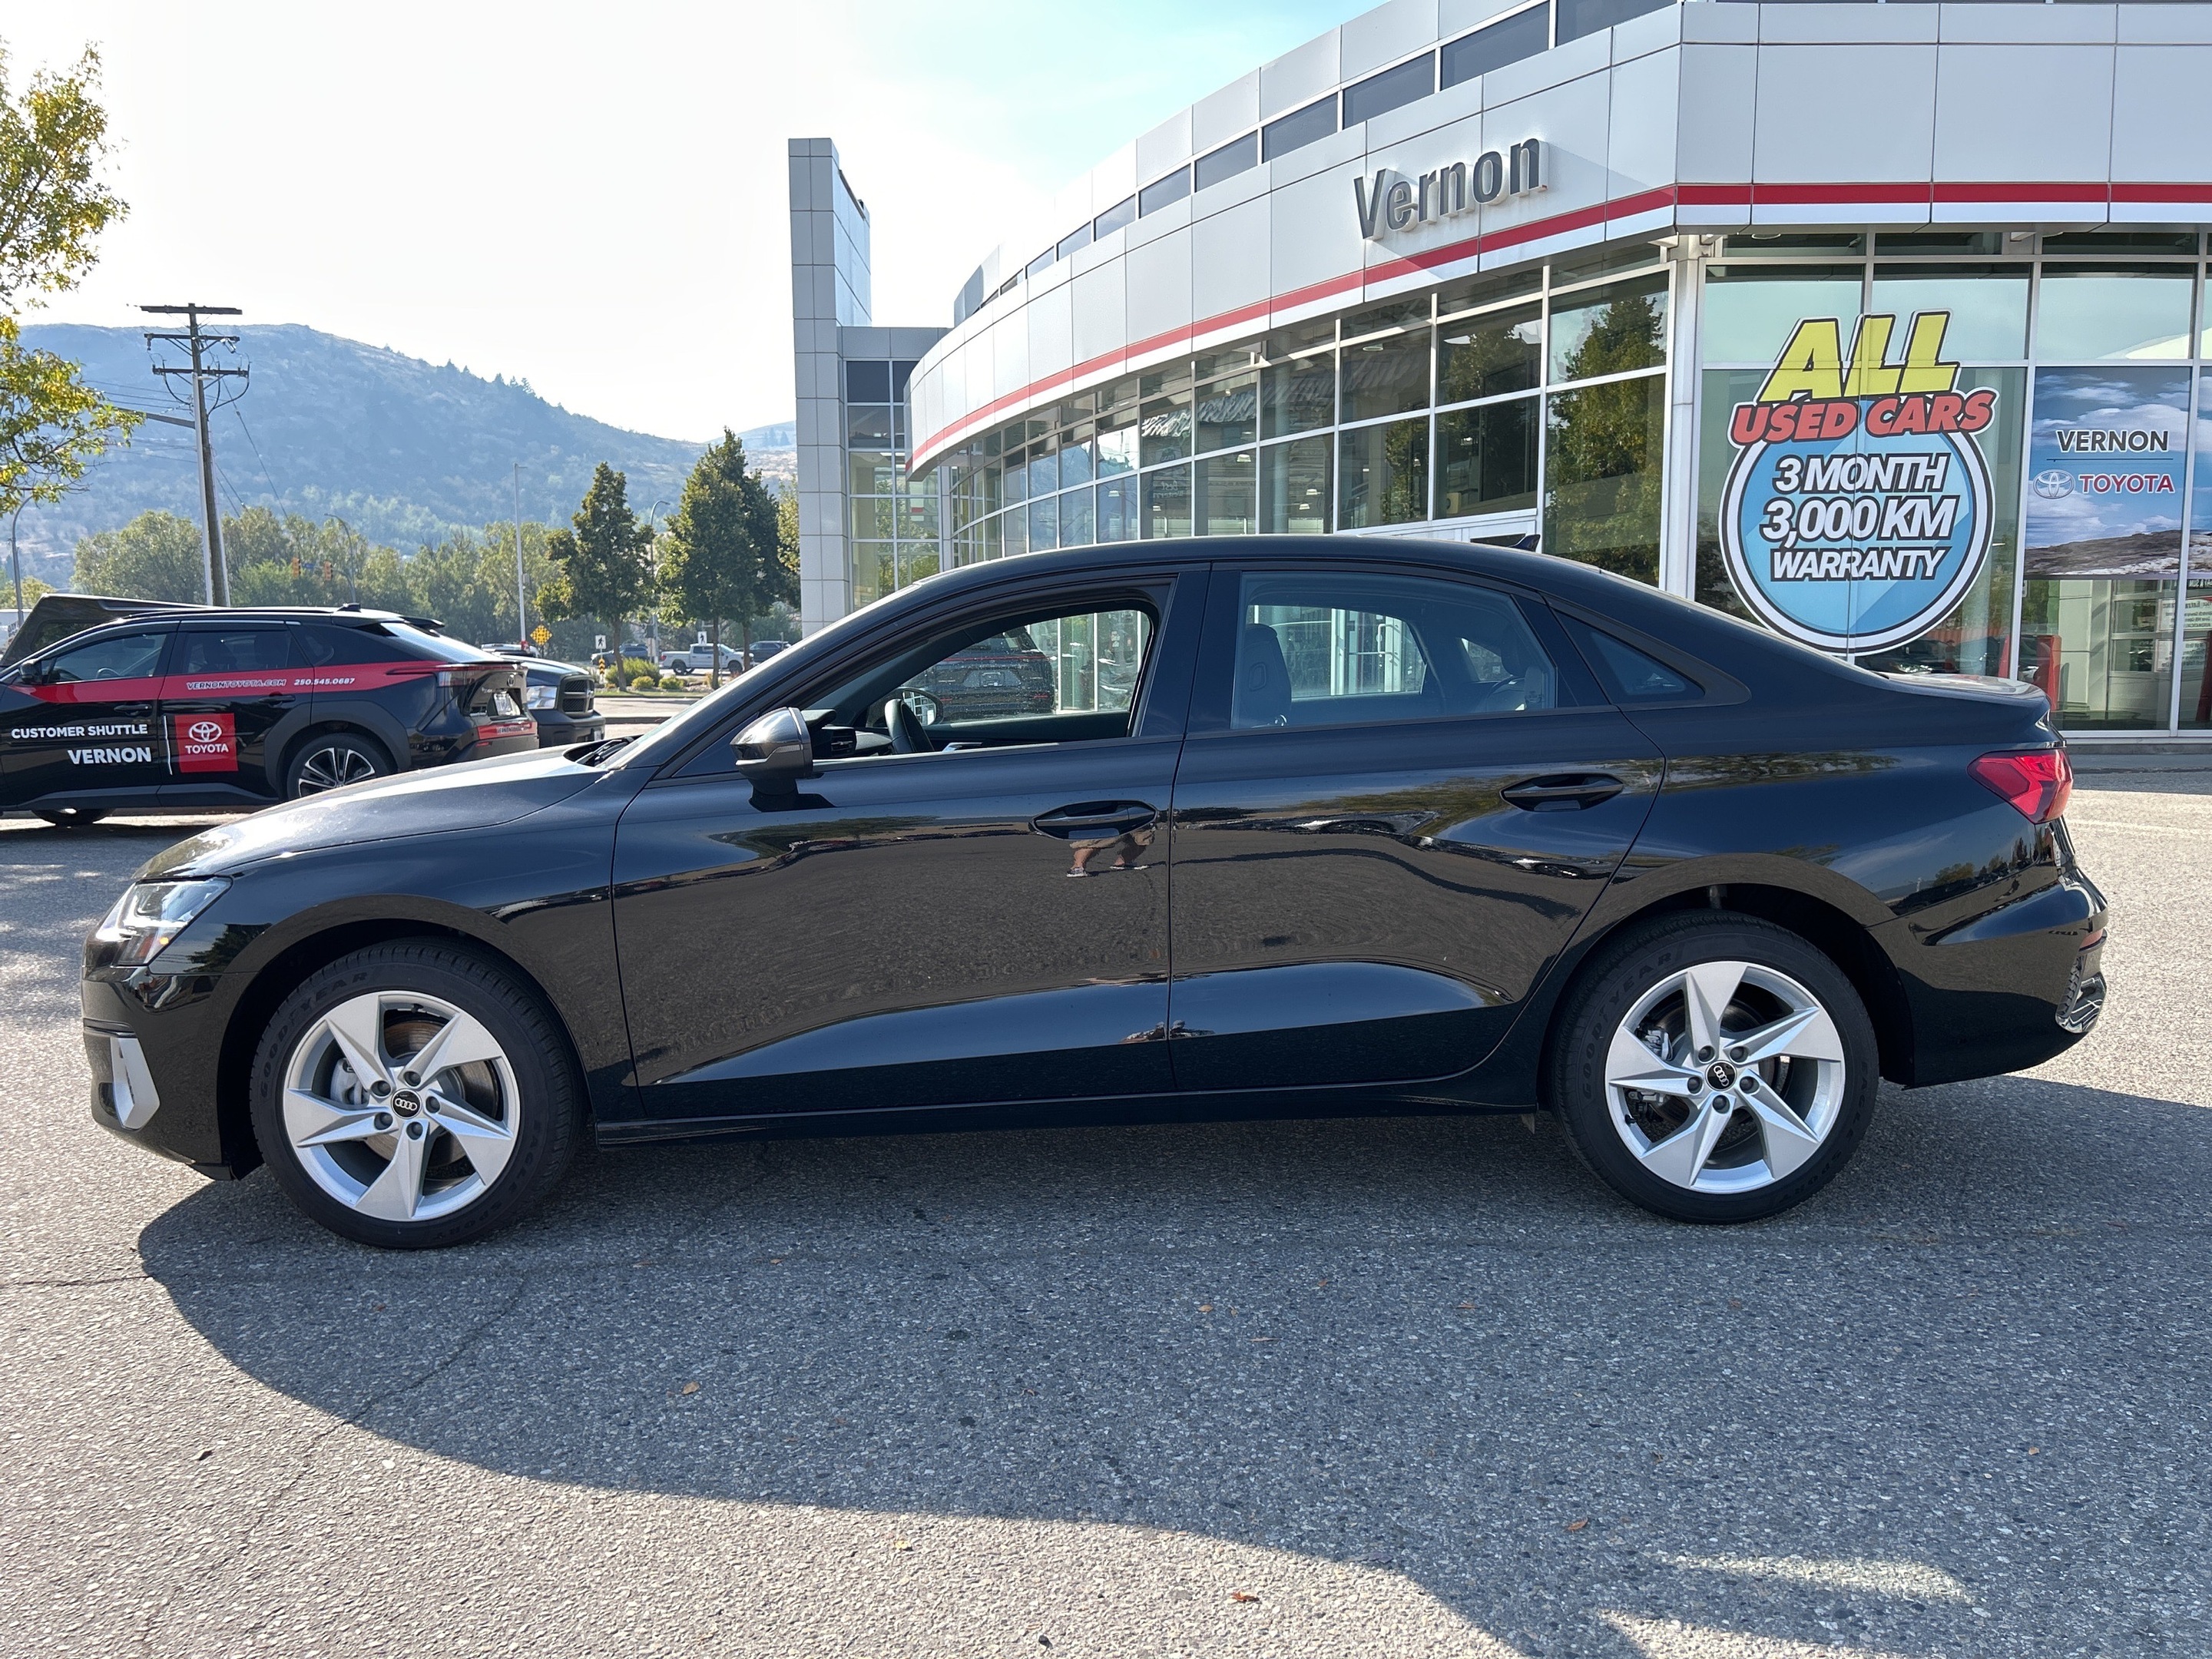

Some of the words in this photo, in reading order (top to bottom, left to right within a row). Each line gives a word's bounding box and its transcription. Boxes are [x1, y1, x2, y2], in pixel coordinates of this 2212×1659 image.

[1353, 138, 1546, 240] Vernon
[1758, 311, 1960, 402] ALL
[1732, 402, 1859, 444] USED
[1866, 390, 1996, 436] CARS
[2056, 430, 2169, 452] VERNON
[1773, 454, 1804, 493] 3
[1800, 453, 1951, 492] MONTH
[2079, 474, 2175, 493] TOYOTA
[1760, 496, 1880, 548] 3,000
[1878, 495, 1960, 540] KM
[1771, 546, 1952, 581] WARRANTY
[187, 679, 286, 690] VERNONTOYOTA.COM
[294, 677, 356, 686] 250.545.0687
[12, 725, 84, 739] CUSTOMER
[88, 724, 148, 736] SHUTTLE
[68, 747, 152, 765] VERNON
[185, 743, 229, 754] TOYOTA
